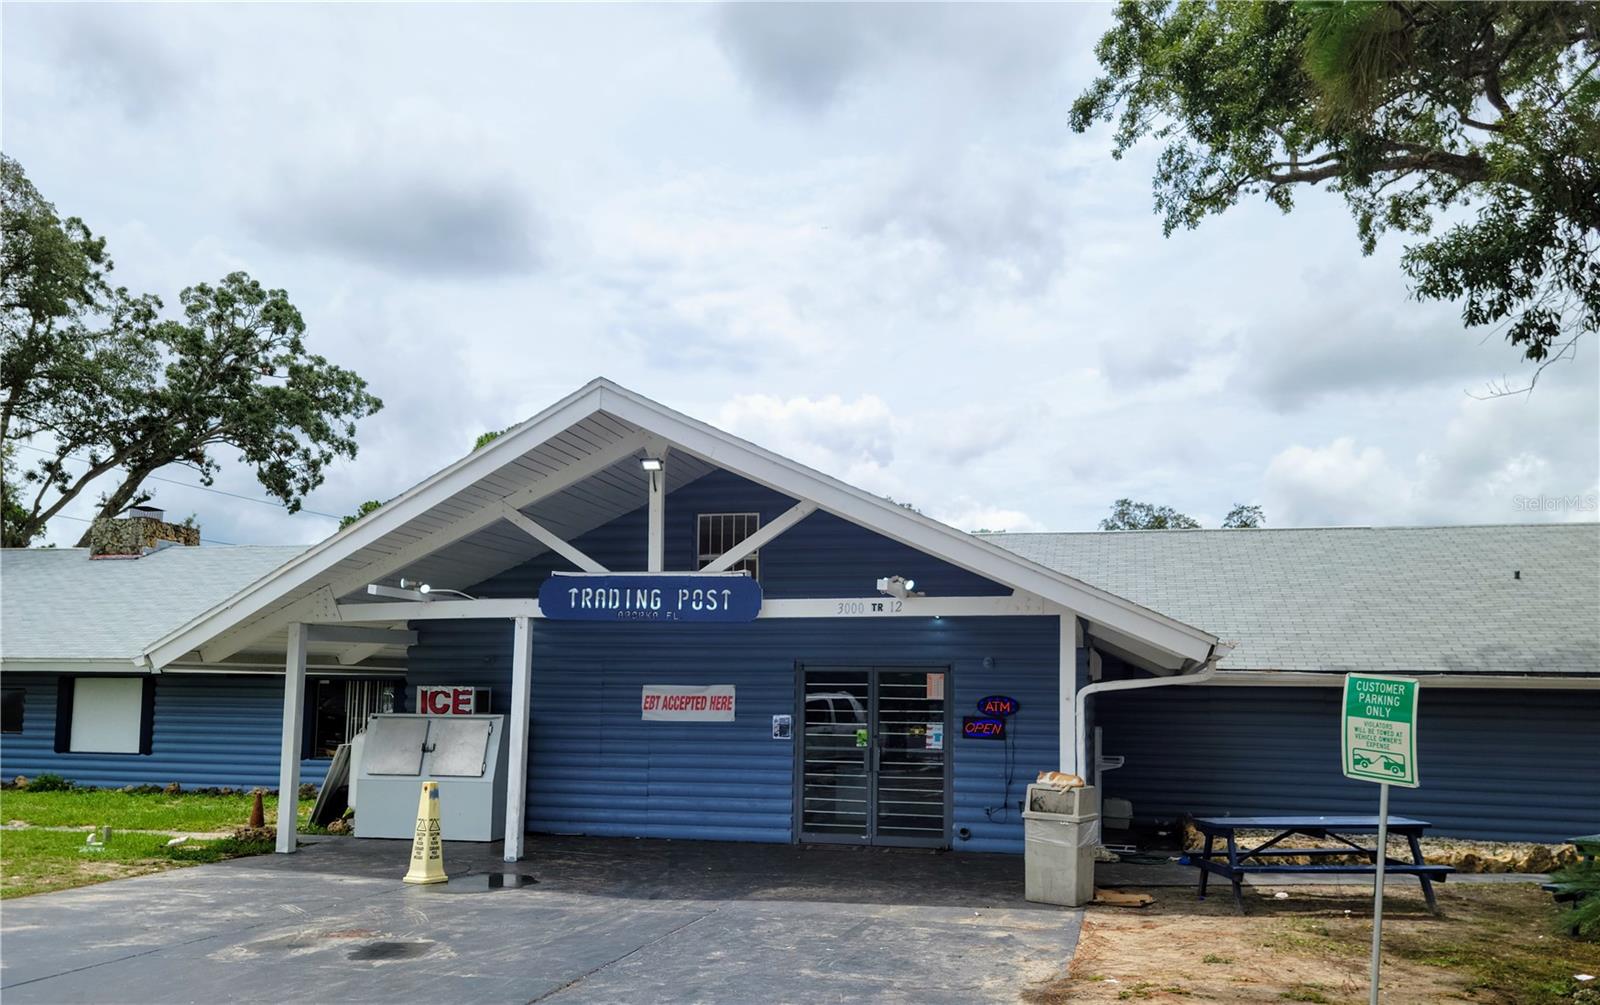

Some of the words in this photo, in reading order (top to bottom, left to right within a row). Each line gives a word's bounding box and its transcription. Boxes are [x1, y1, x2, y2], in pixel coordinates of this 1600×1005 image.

[568, 588, 661, 610] TRADING
[678, 588, 732, 611] POST
[837, 602, 865, 615] 3000
[871, 603, 884, 612] TR
[890, 601, 903, 613] 12
[1356, 681, 1405, 695] CUSTOMER
[421, 688, 473, 715] ICE
[643, 695, 661, 710] EBT
[661, 695, 707, 711] ACCEPTED
[709, 695, 733, 711] HERE
[1358, 693, 1400, 707] PARKING
[985, 701, 1011, 713] ATM
[1366, 705, 1391, 717] ONLY
[965, 722, 1002, 735] OPEN
[1363, 722, 1392, 730] VIOLATORS
[1355, 734, 1377, 742] VEHICLE
[1378, 736, 1403, 745] OWNER'S
[1376, 729, 1394, 737] TOWED
[1366, 741, 1390, 750] EXPENSE
